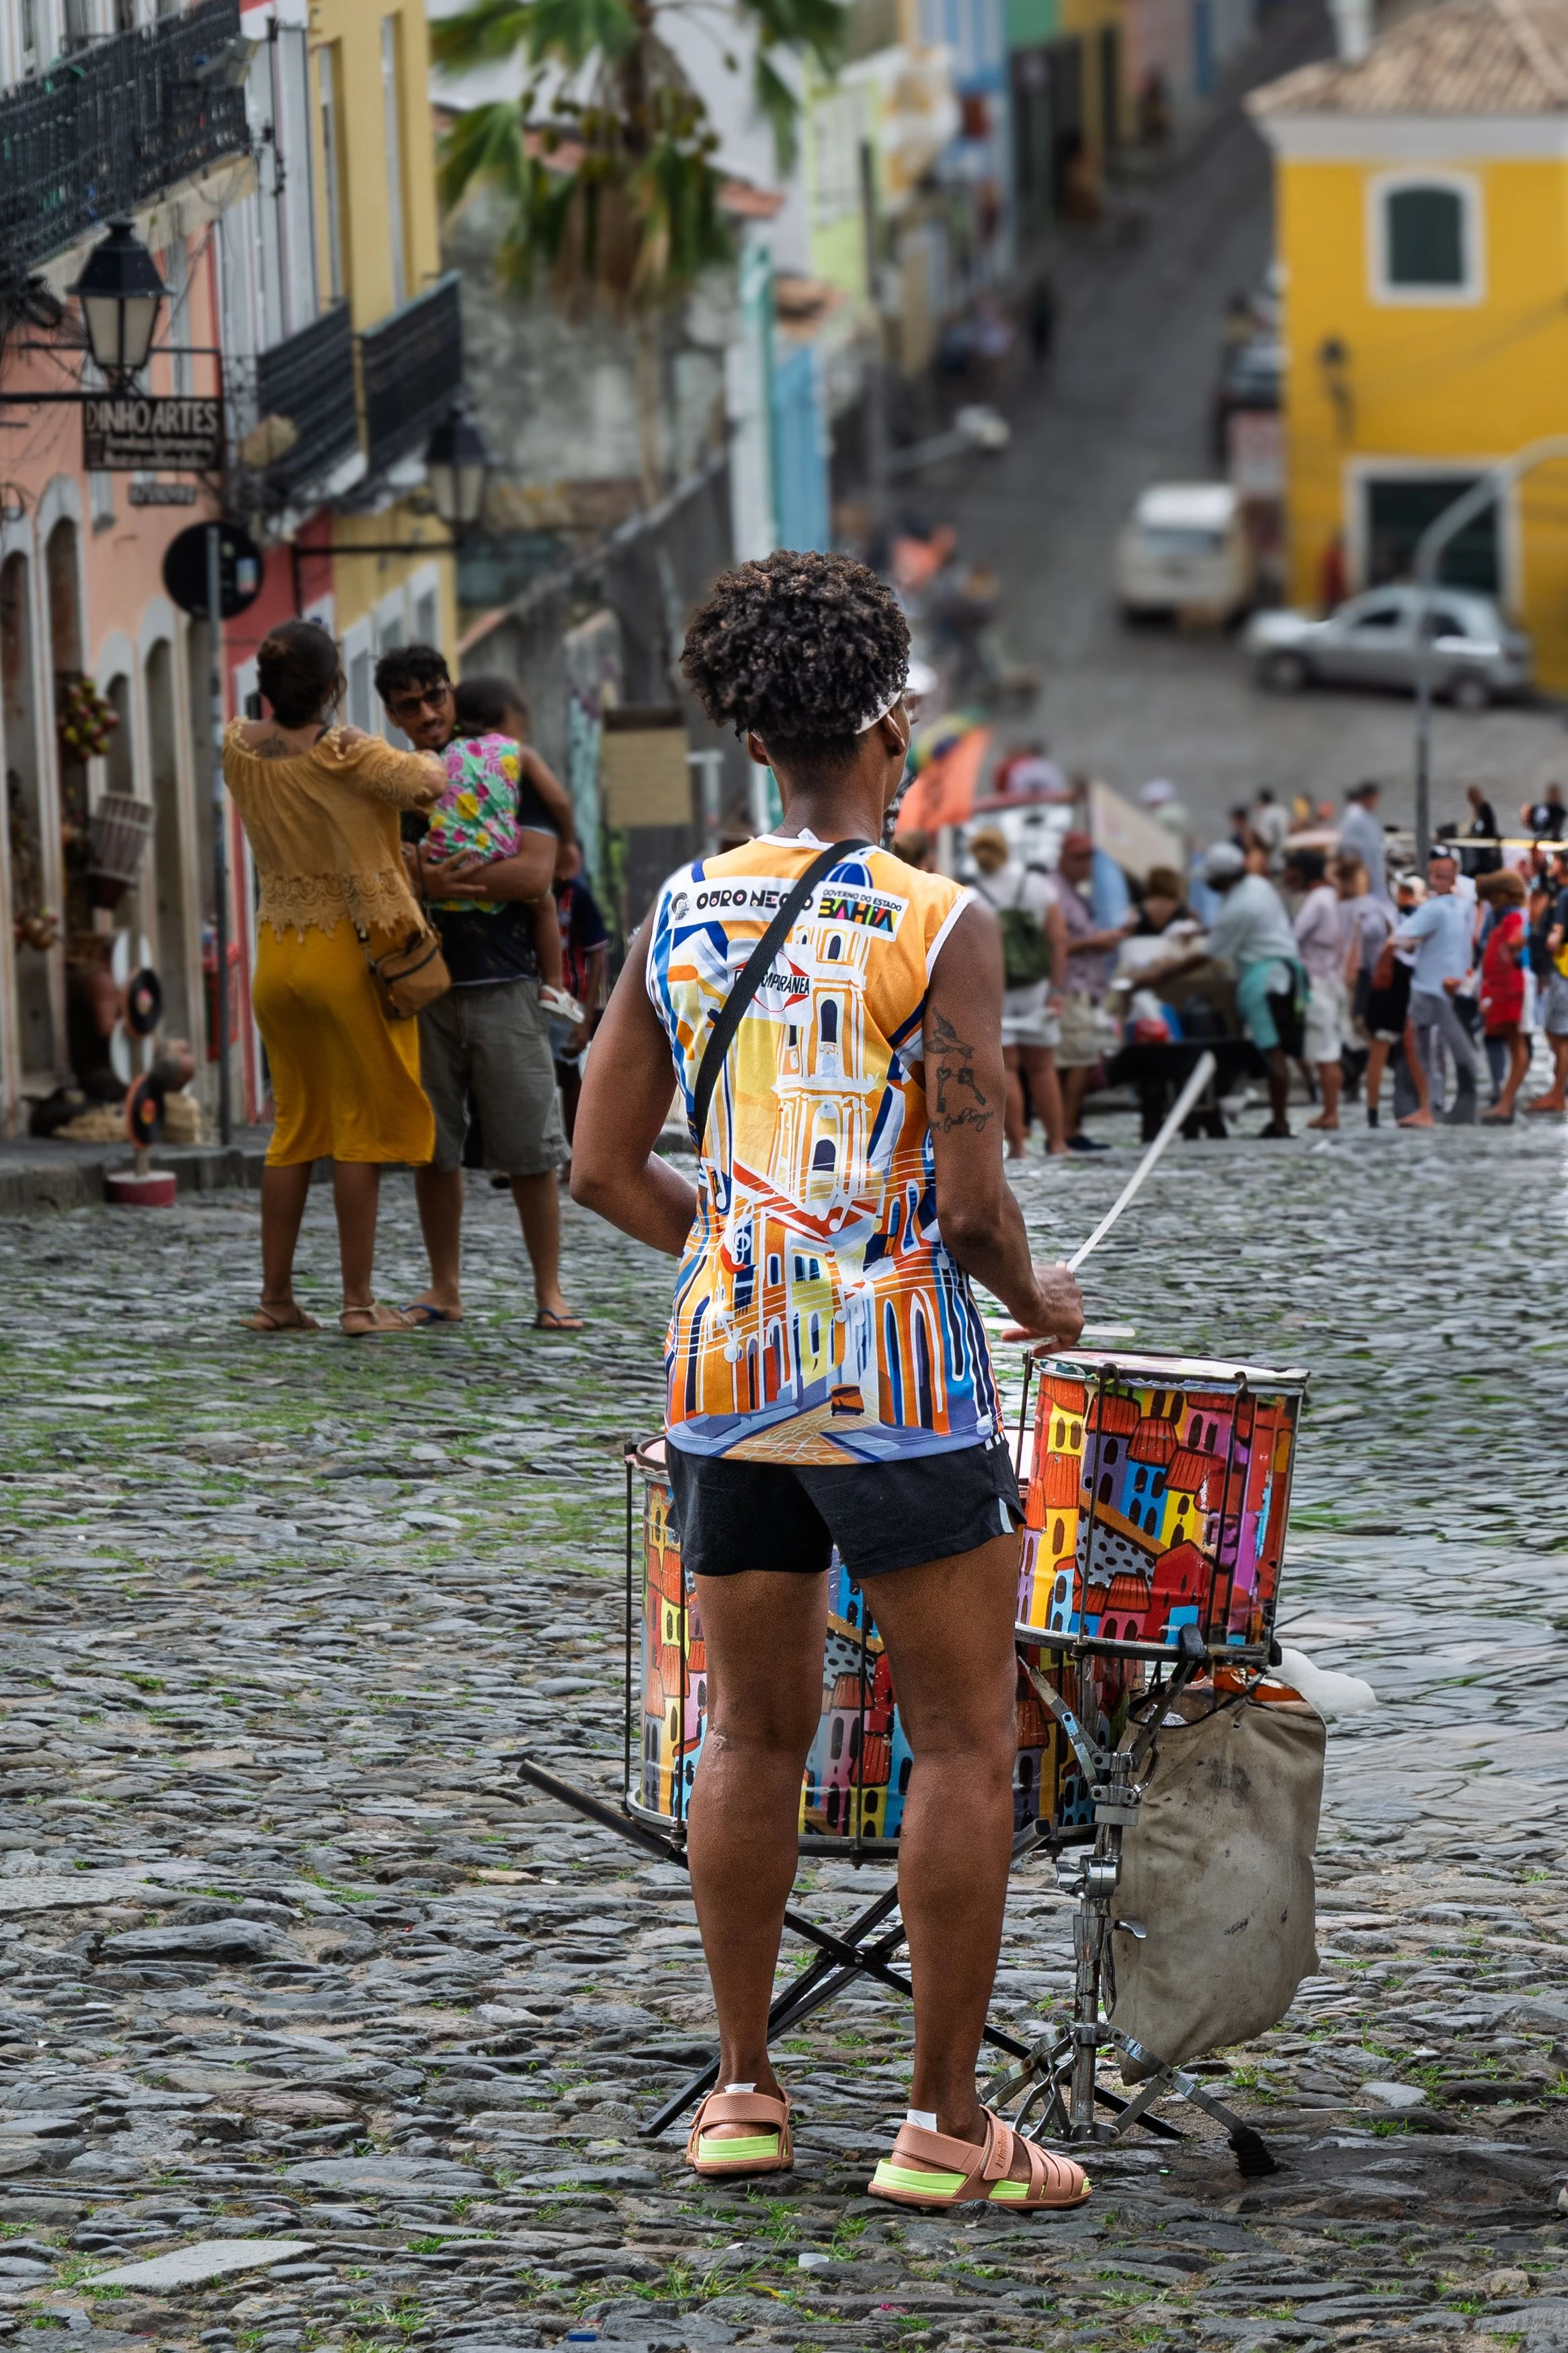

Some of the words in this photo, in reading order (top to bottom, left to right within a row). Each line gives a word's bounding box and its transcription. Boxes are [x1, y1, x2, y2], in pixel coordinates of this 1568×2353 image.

[86, 400, 151, 434] DINHO
[151, 401, 218, 433] ARTES
[696, 889, 747, 910] OURO
[823, 889, 859, 900] GOVERNO
[860, 894, 872, 903] DO
[873, 898, 902, 912] ESTADO
[818, 898, 895, 933] BAHIA
